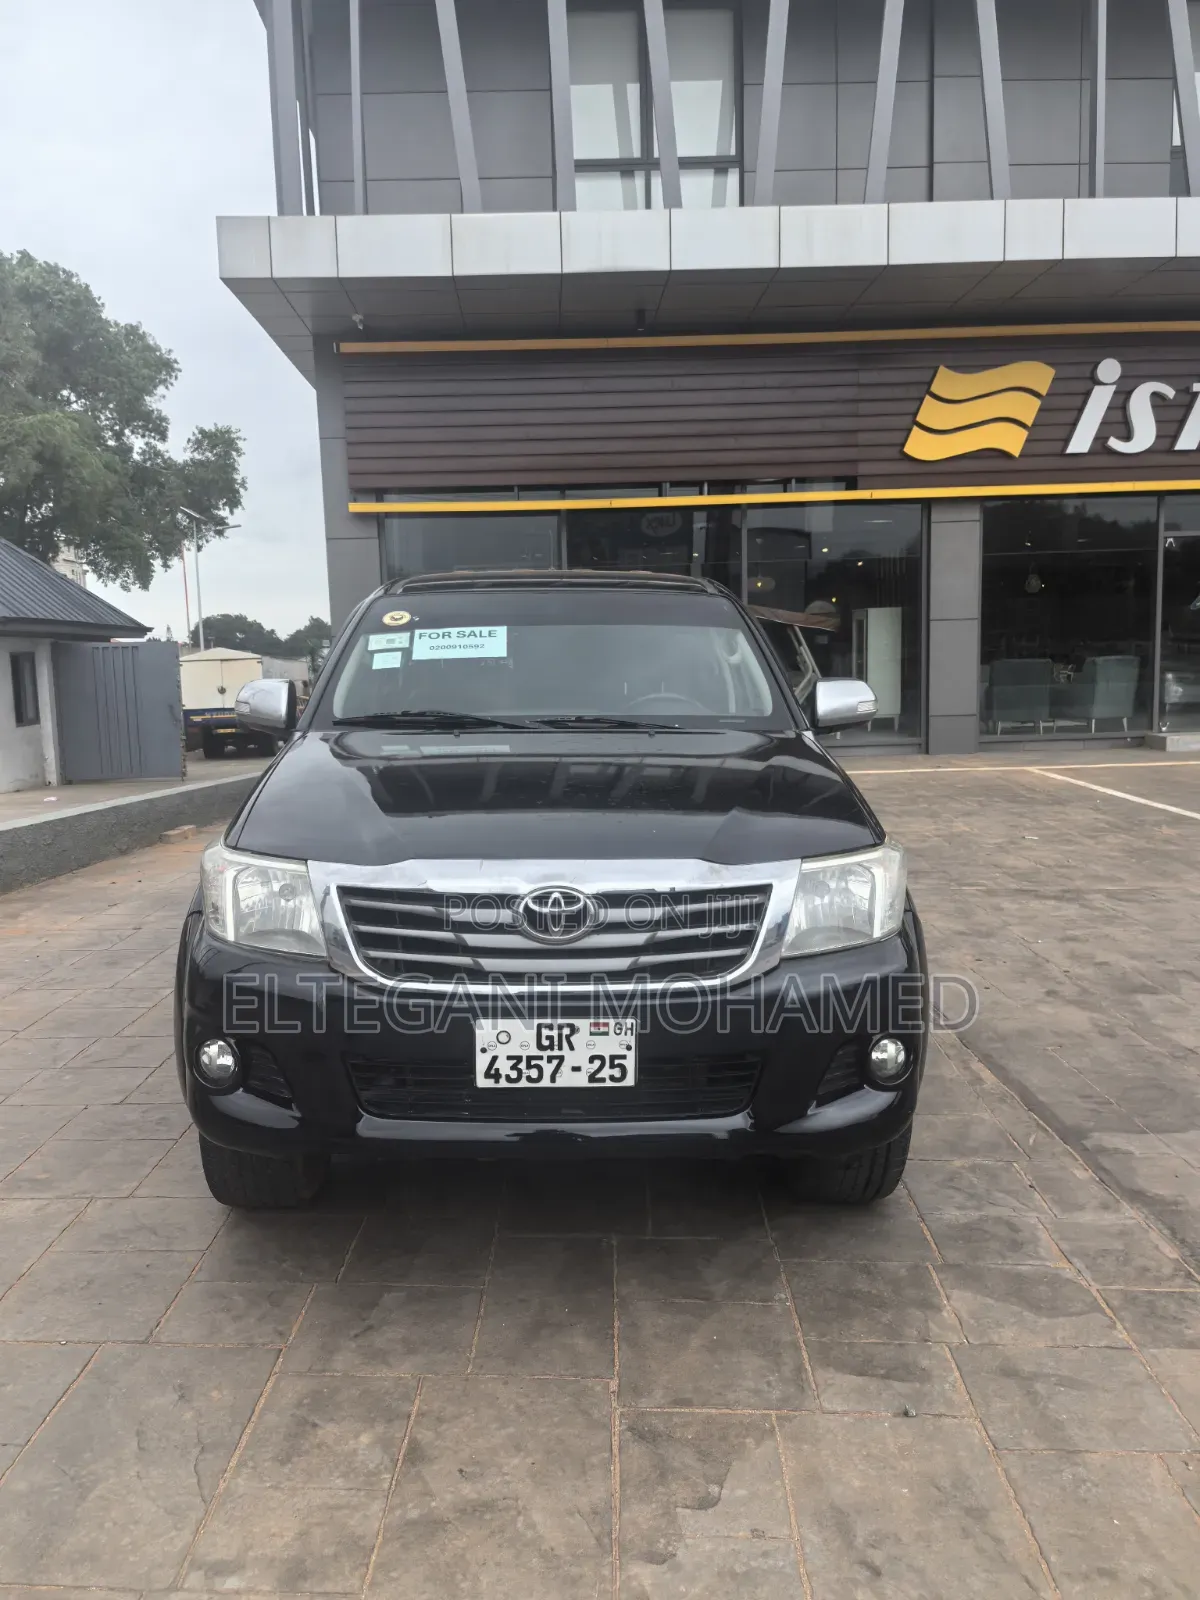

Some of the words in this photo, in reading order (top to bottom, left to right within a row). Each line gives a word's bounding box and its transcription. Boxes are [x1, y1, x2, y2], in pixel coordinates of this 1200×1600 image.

[418, 631, 452, 640] FOR
[456, 629, 498, 639] SALE
[536, 1022, 576, 1052] GR
[613, 1021, 634, 1037] GH
[483, 1054, 628, 1084] 4357-25
